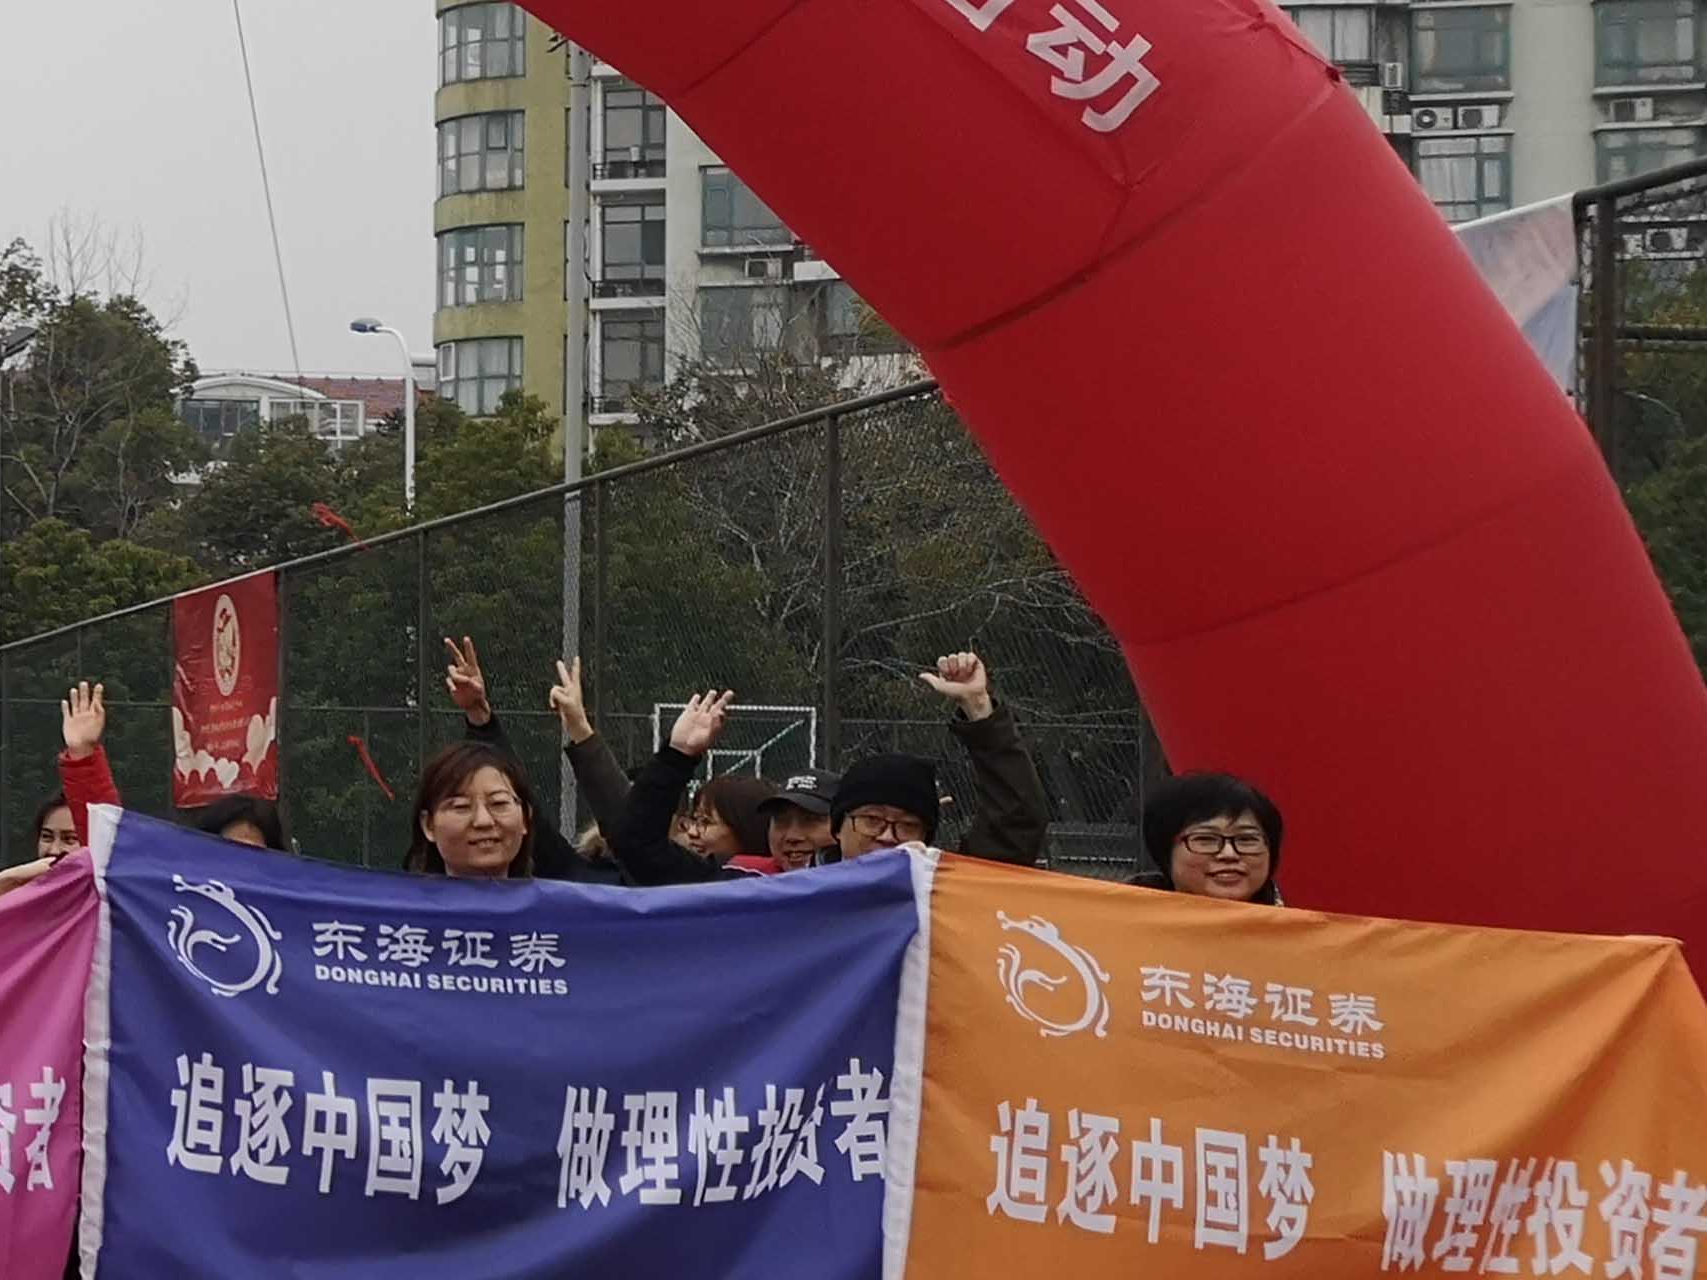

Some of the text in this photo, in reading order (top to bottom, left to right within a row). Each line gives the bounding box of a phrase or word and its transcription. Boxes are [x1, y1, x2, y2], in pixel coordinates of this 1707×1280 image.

[312, 920, 567, 973] 东海证券
[314, 964, 570, 996] DONGHAI SECURITIES
[1139, 964, 1386, 1035] 东海证券
[1142, 1010, 1386, 1059] DONGHAI SECURITIES
[166, 1052, 492, 1205] 追逐中国梦
[986, 1097, 1315, 1261] 追逐中国梦
